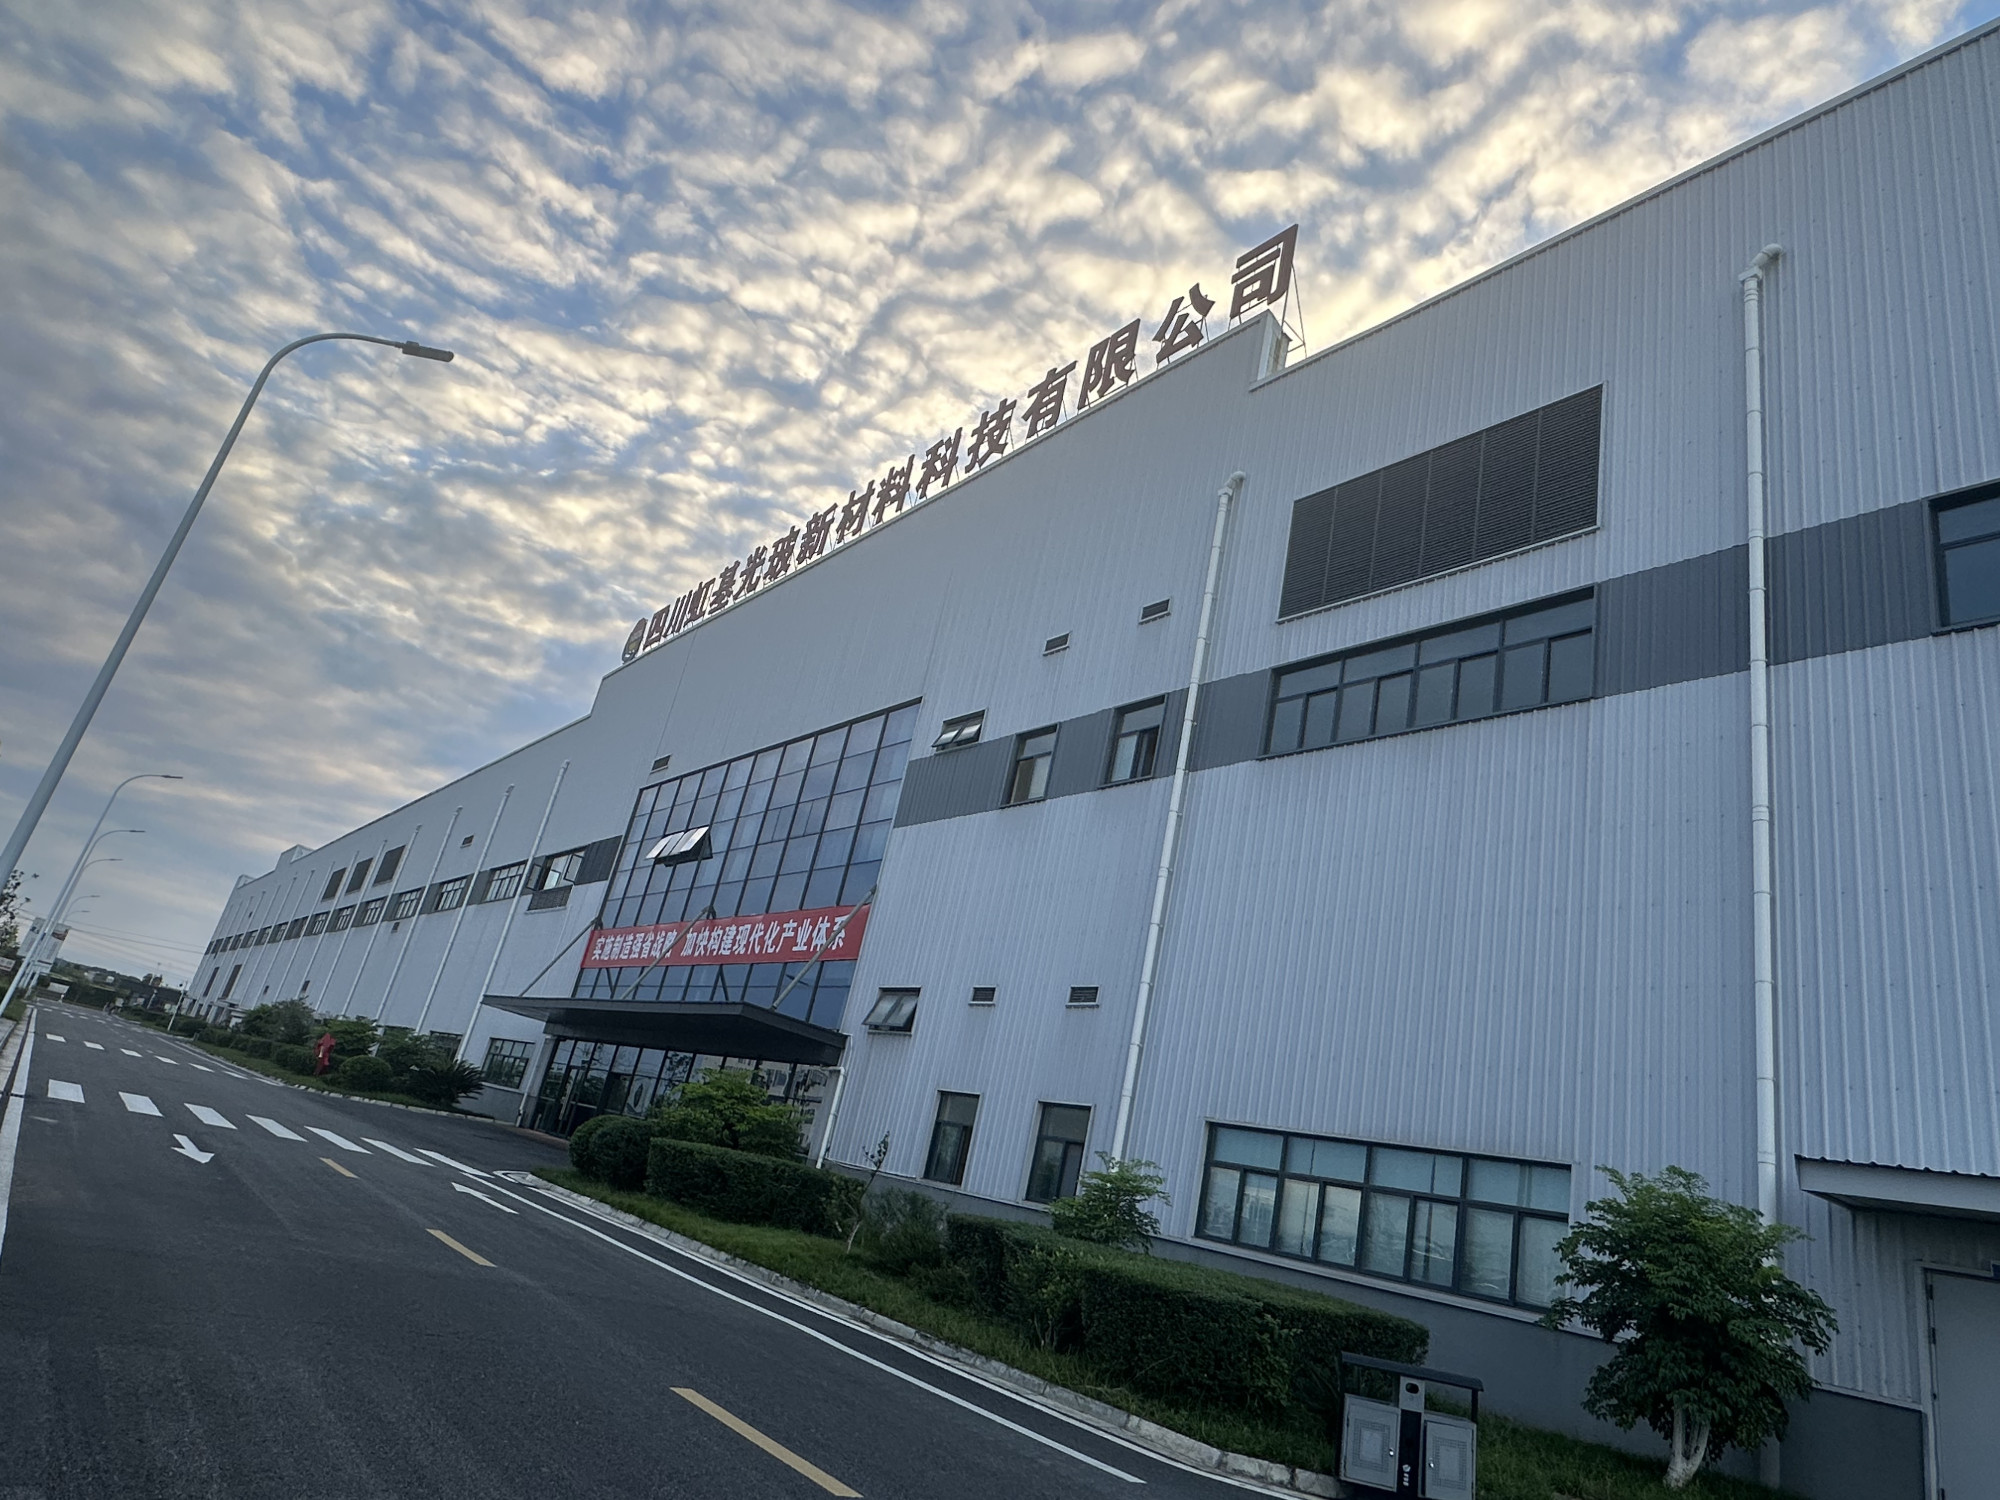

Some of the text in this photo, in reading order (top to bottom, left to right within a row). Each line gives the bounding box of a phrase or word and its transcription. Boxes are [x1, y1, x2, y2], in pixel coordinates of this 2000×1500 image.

[643, 224, 1298, 651] 四川虹基光玻新材料科技有限公司
[681, 915, 850, 957] 加快构建现代化产业体系
